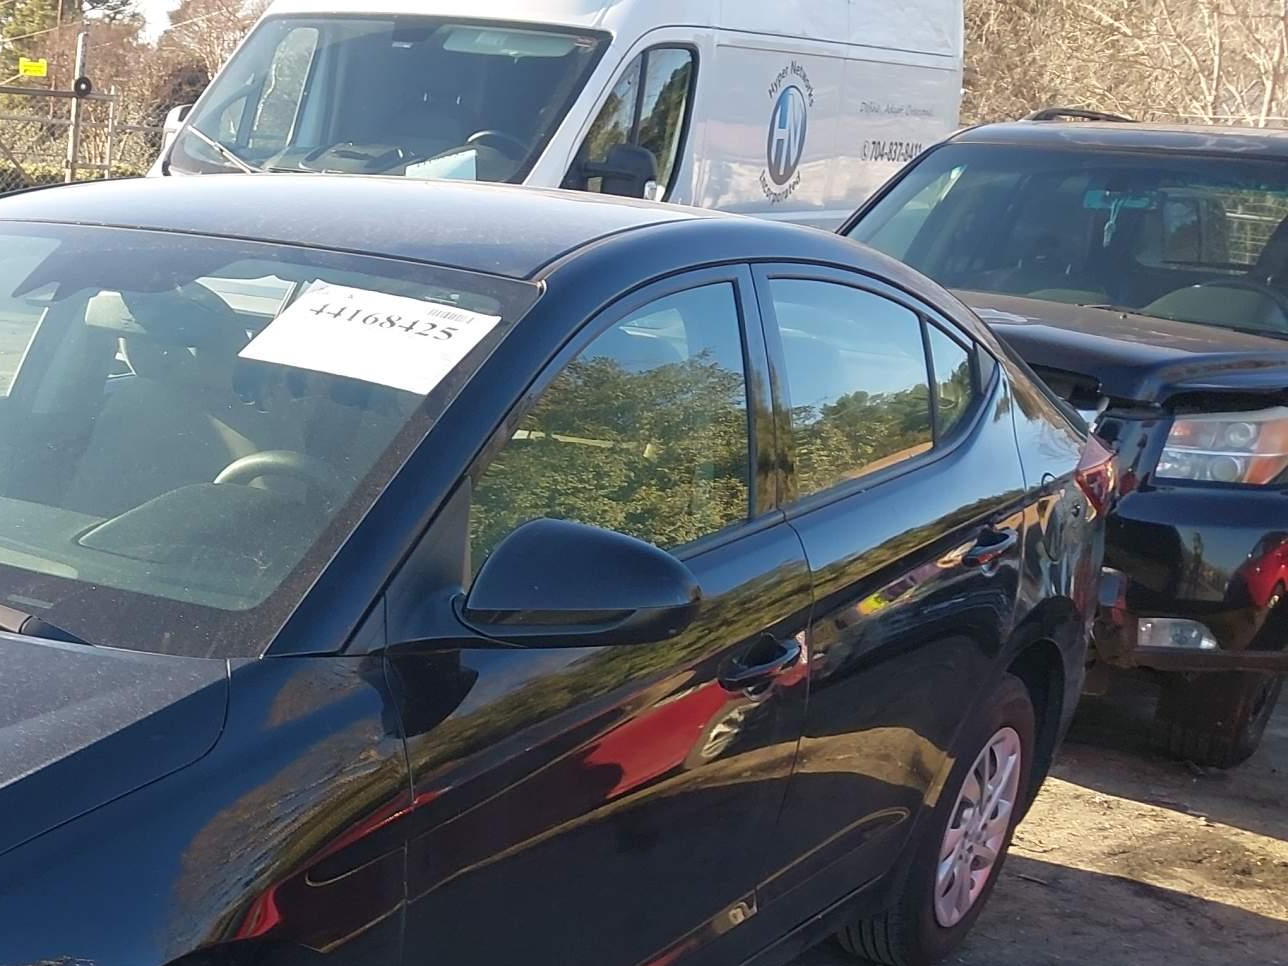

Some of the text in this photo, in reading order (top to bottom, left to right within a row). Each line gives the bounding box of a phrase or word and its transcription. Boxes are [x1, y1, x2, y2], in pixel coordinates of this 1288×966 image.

[768, 66, 789, 98] Hyper
[759, 169, 801, 206] Incorporated
[309, 303, 460, 341] 44168425
